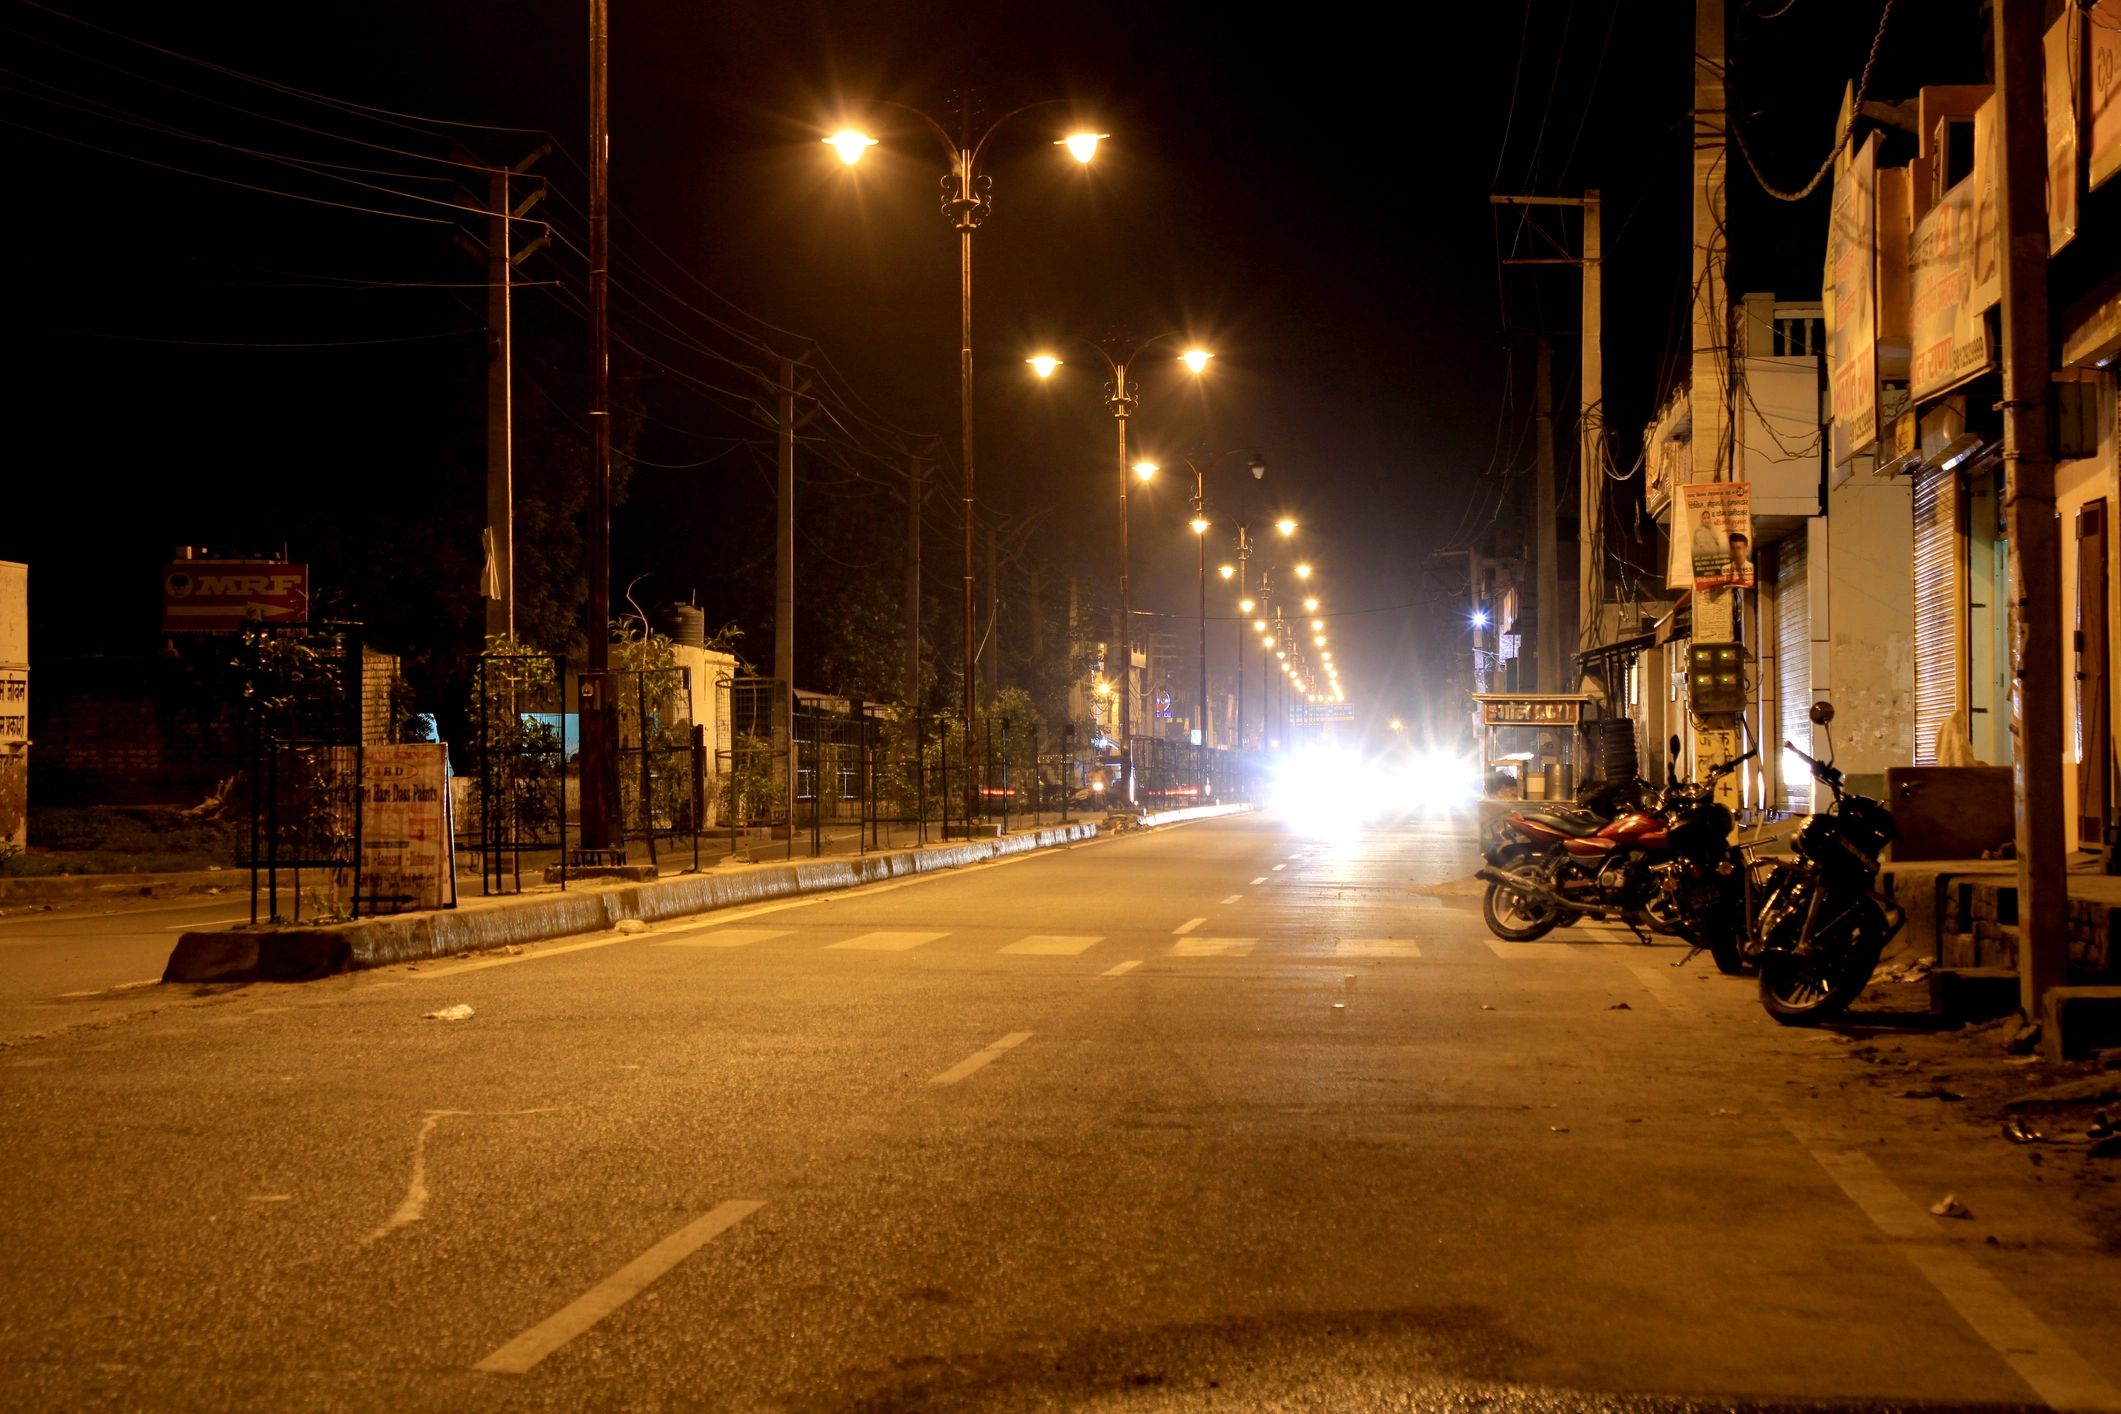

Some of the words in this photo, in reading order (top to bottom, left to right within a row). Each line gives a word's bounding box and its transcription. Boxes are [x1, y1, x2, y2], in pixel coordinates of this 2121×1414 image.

[195, 575, 302, 596] MRF
[373, 784, 390, 802] Hari
[393, 784, 410, 802] Dass
[413, 784, 438, 802] Paints
